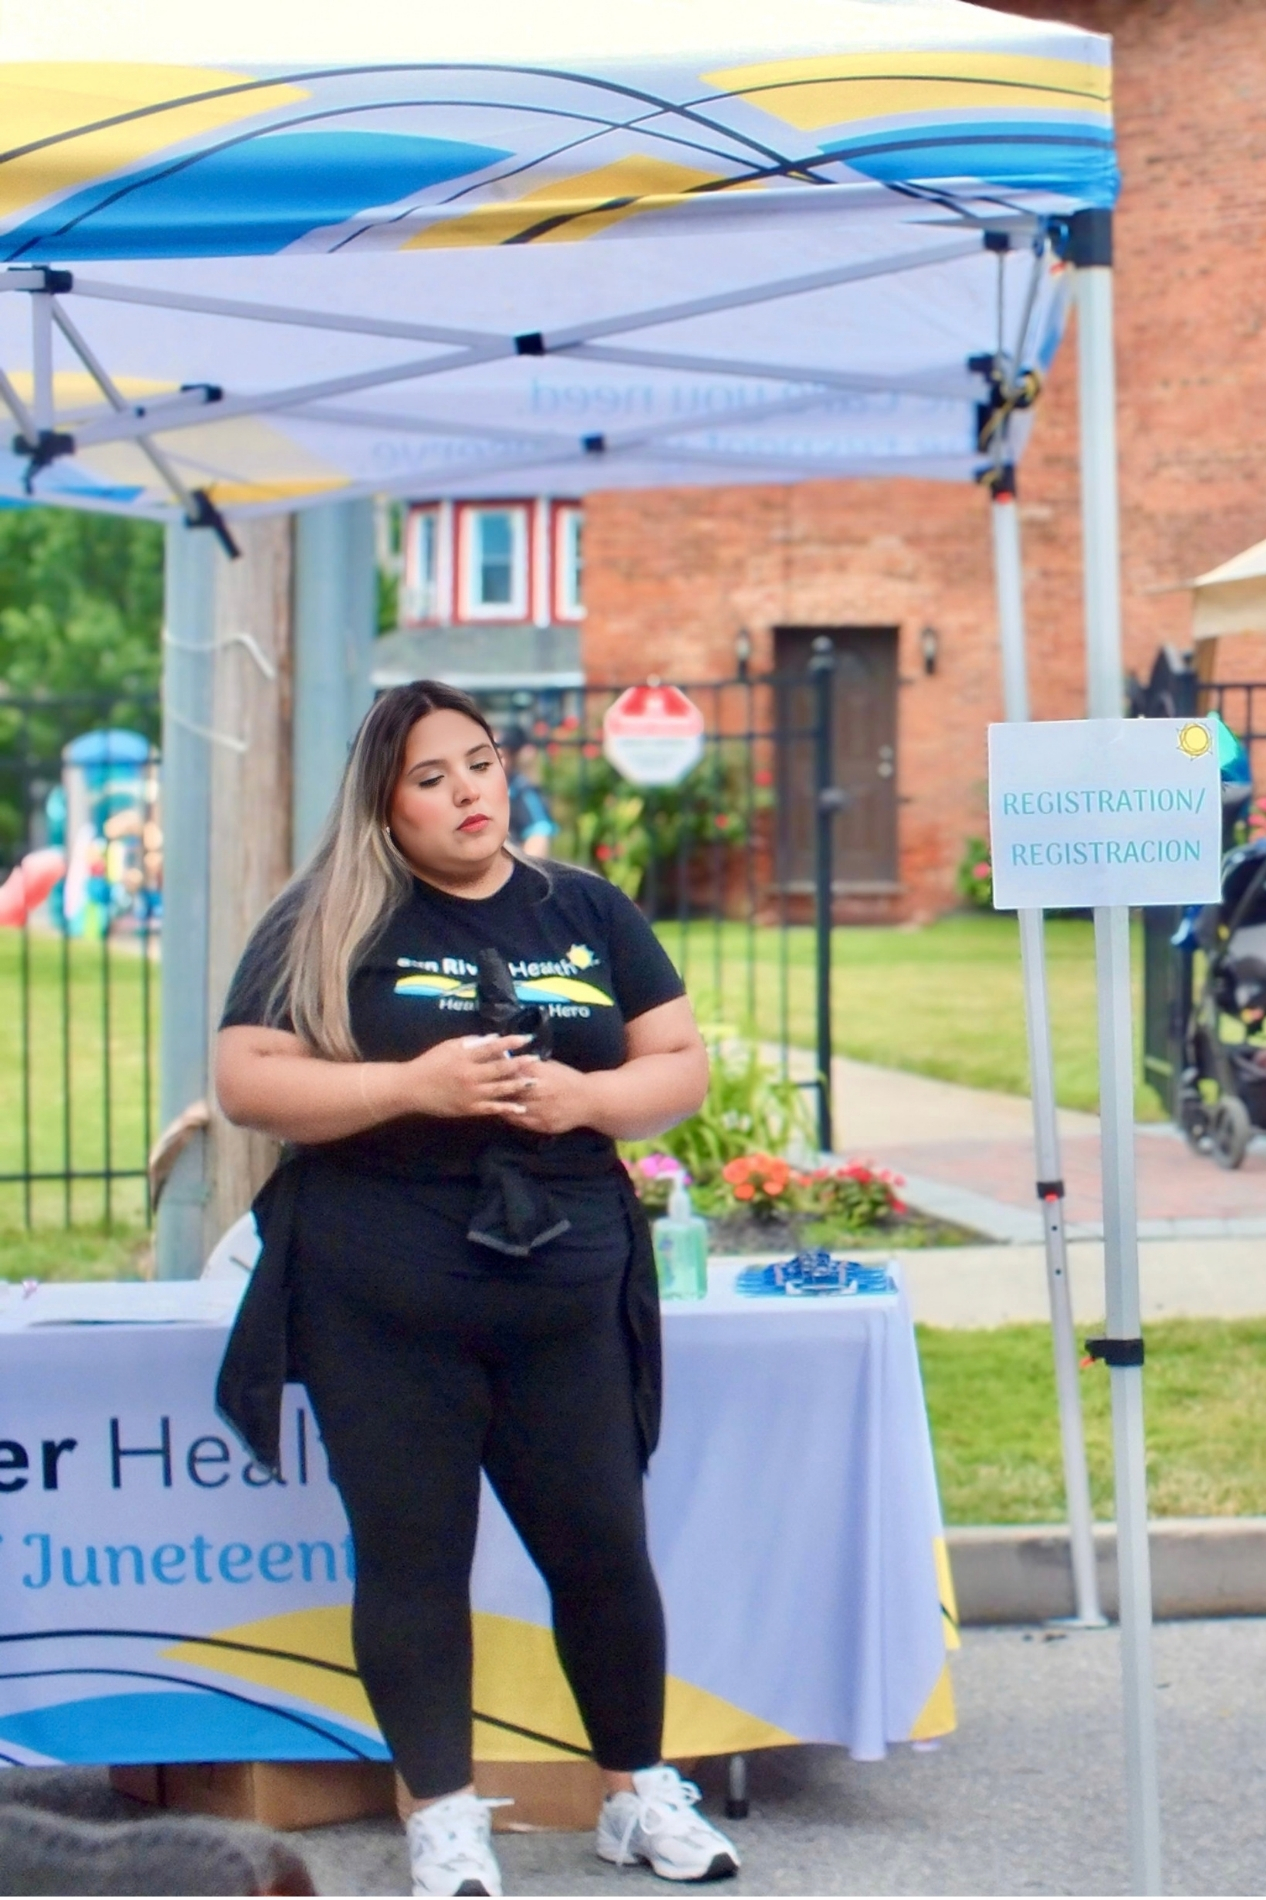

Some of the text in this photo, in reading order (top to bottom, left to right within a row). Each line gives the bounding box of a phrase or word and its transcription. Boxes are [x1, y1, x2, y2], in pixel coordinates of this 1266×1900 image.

[1003, 788, 1206, 815] REGISTRATION/
[1012, 840, 1201, 866] REGISTRACION
[442, 957, 479, 976] Riv
[508, 958, 578, 977] Health
[548, 1003, 591, 1018] Hero
[110, 1408, 308, 1489] Heal
[23, 1532, 356, 1589] Juneteent
